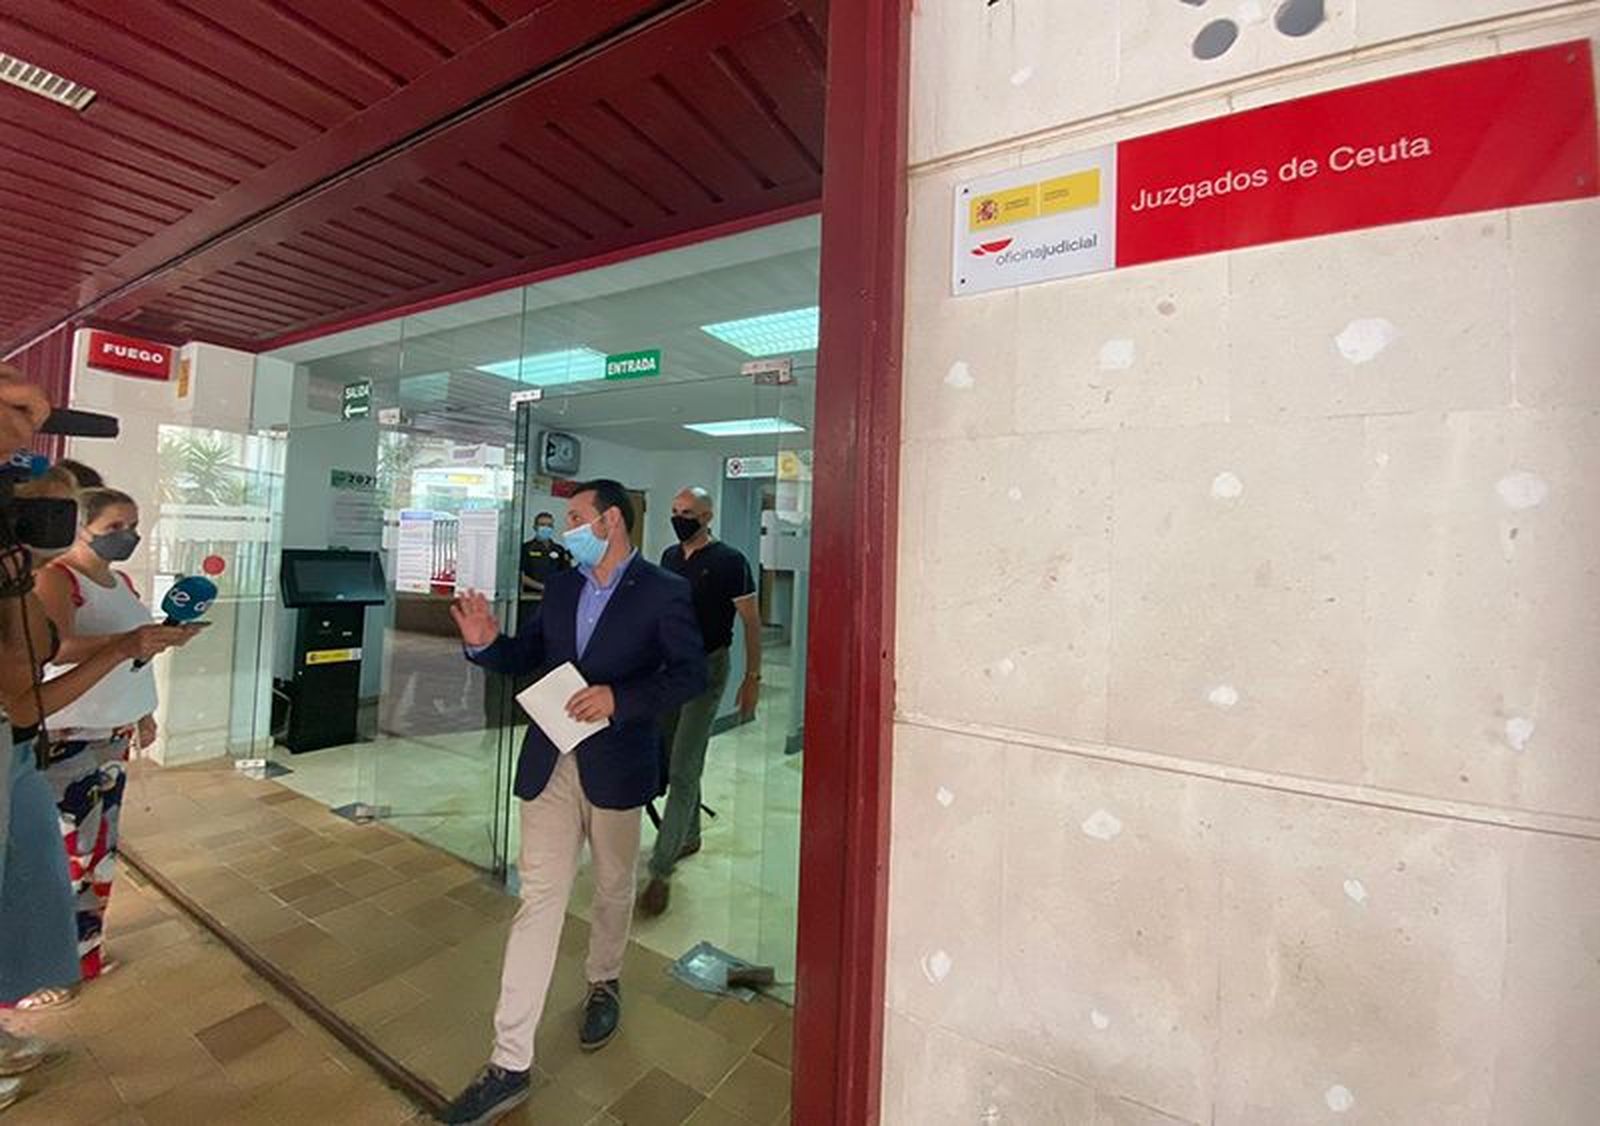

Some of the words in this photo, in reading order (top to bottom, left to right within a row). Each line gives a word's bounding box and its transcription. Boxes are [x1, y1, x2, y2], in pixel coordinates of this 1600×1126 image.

[1131, 168, 1269, 212] Juzgados
[1279, 158, 1318, 182] de
[1329, 136, 1431, 172] Ceuta
[102, 343, 164, 364] FUEGO
[608, 357, 656, 375] ENTRADA
